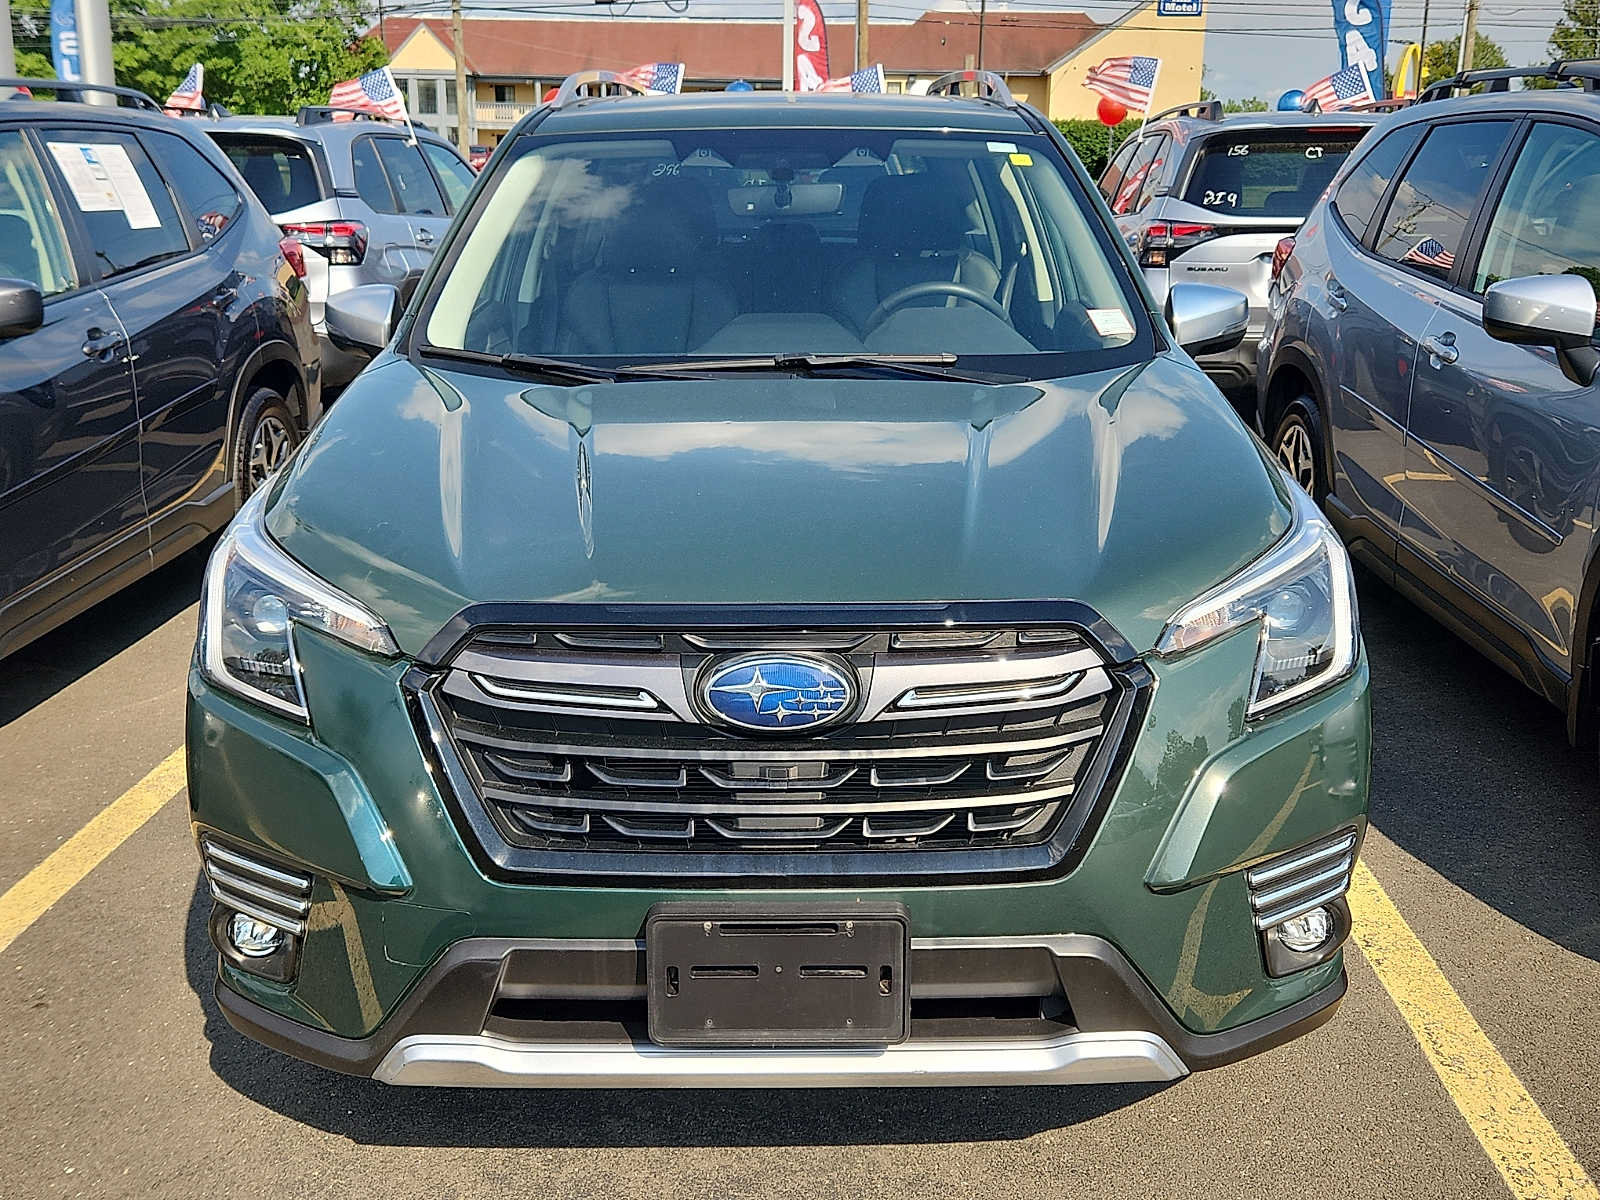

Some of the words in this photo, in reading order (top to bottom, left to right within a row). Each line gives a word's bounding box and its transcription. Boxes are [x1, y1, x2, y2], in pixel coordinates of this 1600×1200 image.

[1165, 3, 1197, 11] Motel
[1227, 145, 1249, 157] 156
[1305, 147, 1324, 158] CT
